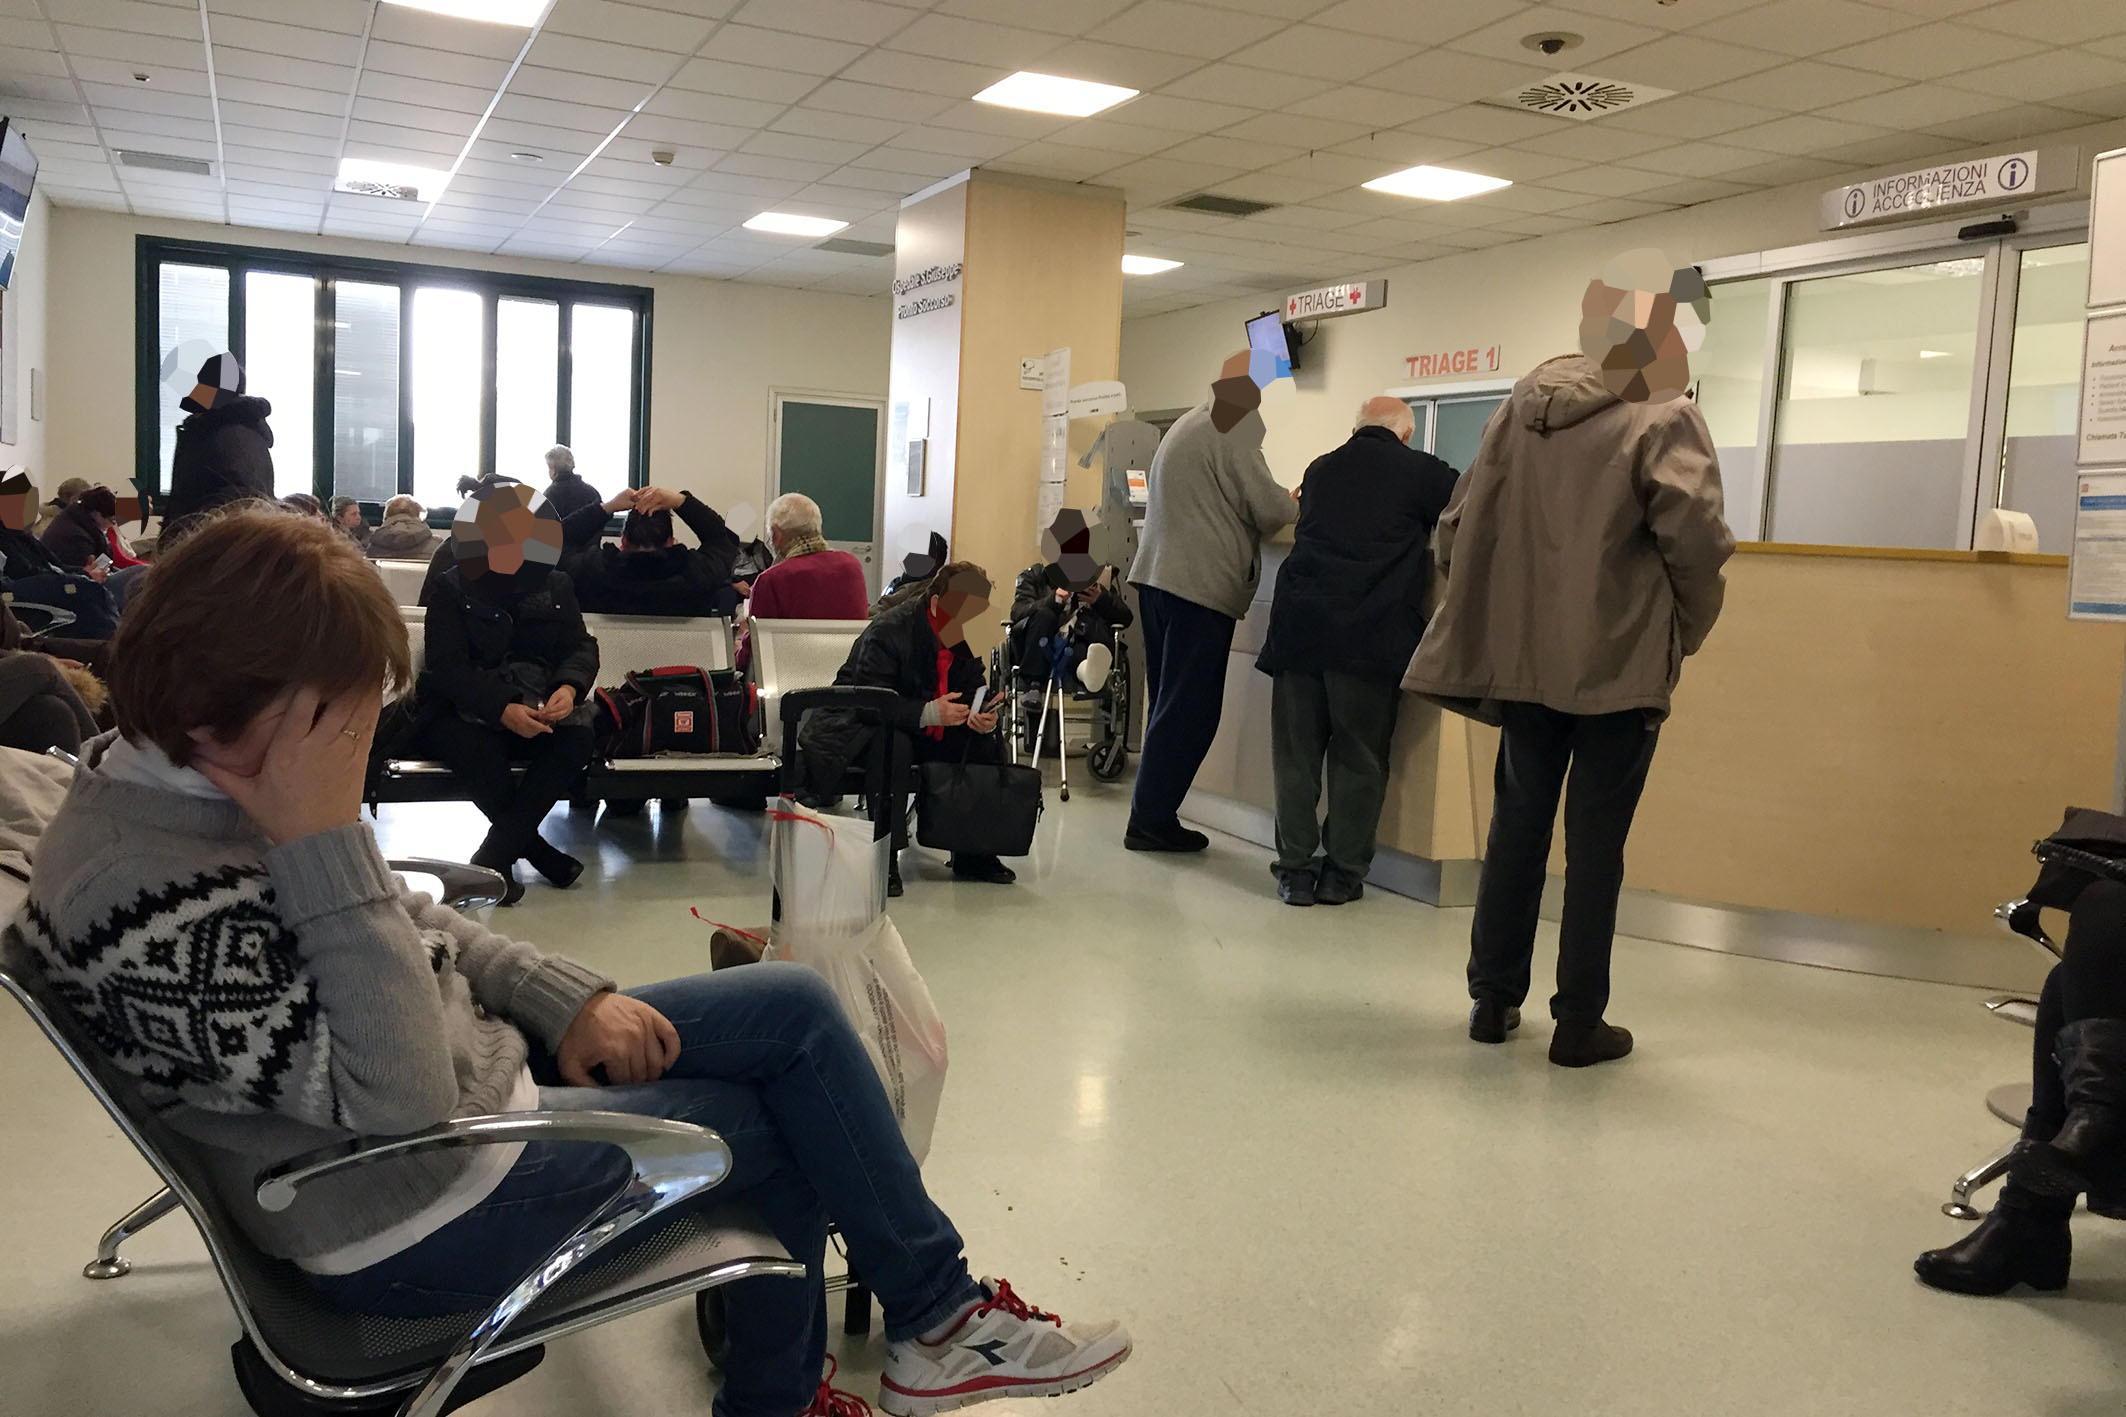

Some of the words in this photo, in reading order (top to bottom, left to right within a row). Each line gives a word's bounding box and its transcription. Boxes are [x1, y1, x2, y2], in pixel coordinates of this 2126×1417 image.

[1873, 163, 1988, 198] INFORMAZIONI
[1298, 288, 1344, 313] TRIAGE
[1406, 349, 1479, 377] TRIAGE
[1486, 346, 1496, 369] 1
